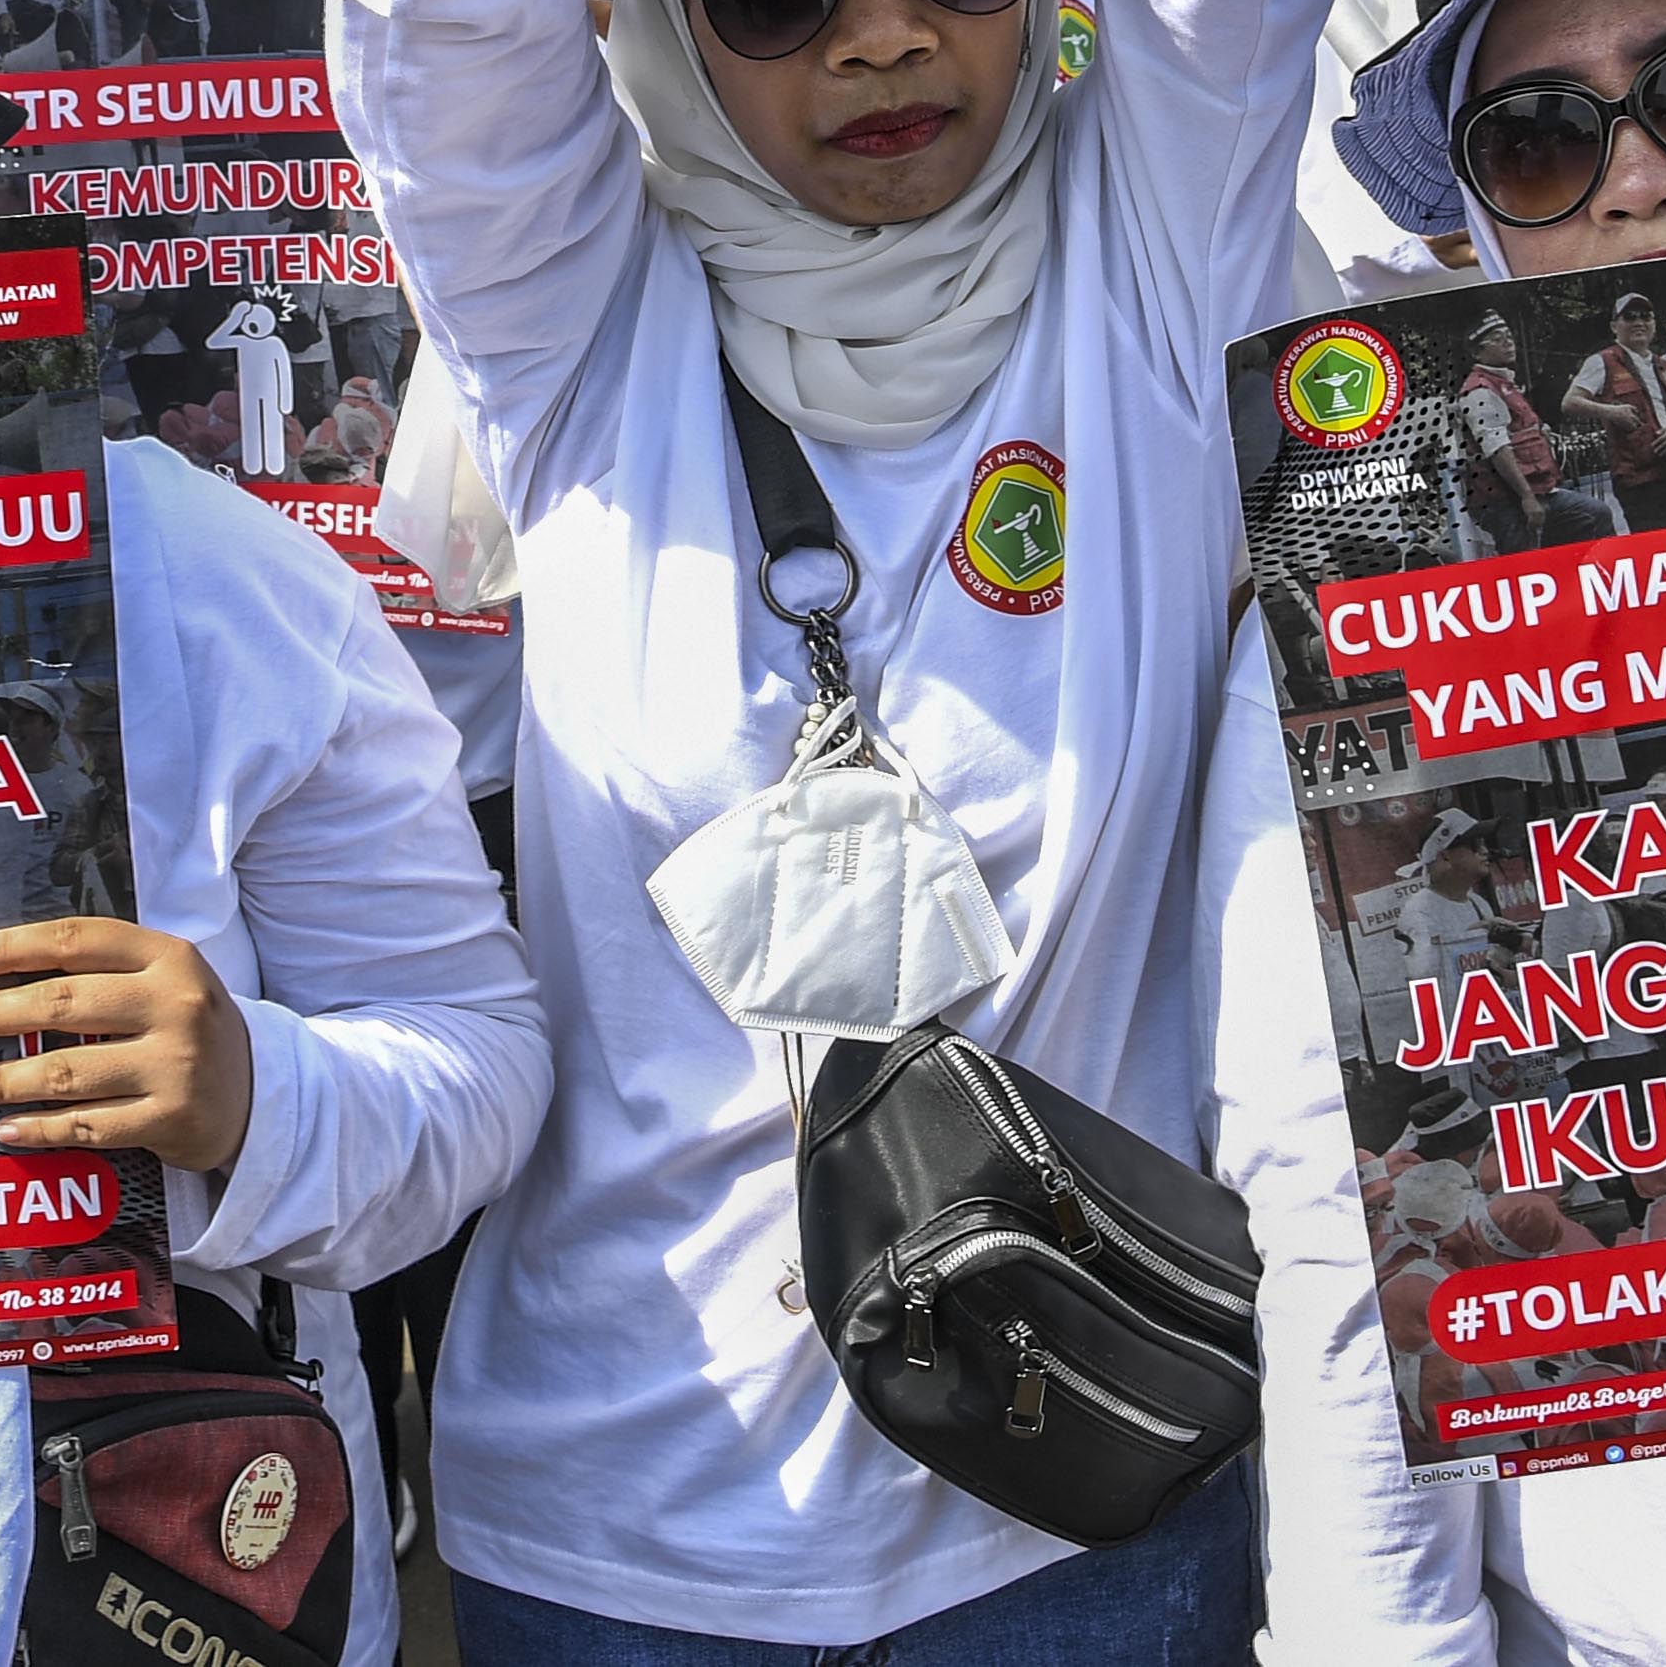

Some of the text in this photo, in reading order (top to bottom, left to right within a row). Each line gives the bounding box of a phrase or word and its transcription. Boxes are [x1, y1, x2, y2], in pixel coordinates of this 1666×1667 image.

[96, 77, 324, 126] SEUMUR
[28, 159, 375, 219] KEMUNDUR
[88, 234, 401, 296] OMPETENSI
[1278, 326, 1397, 432] PERSATUAN PERAWAT NASIONAL INDONESIA
[1325, 428, 1368, 447] PPNI
[997, 448, 1055, 477] NASIONAL
[1300, 457, 1406, 490] DPW PPNI
[1292, 473, 1427, 510] DKI JAKARTA
[1029, 580, 1065, 612] PPN
[1327, 571, 1559, 656] CUKUP
[1411, 660, 1607, 739] YANG
[38, 1288, 65, 1307] 38
[70, 1280, 123, 1303] 2014
[62, 1332, 169, 1355] www.ppnidki.org
[1411, 1469, 1464, 1487] Follow
[1469, 1462, 1491, 1477] Us
[1527, 1452, 1589, 1473] @ppnidki
[131, 1599, 265, 1667] CON
